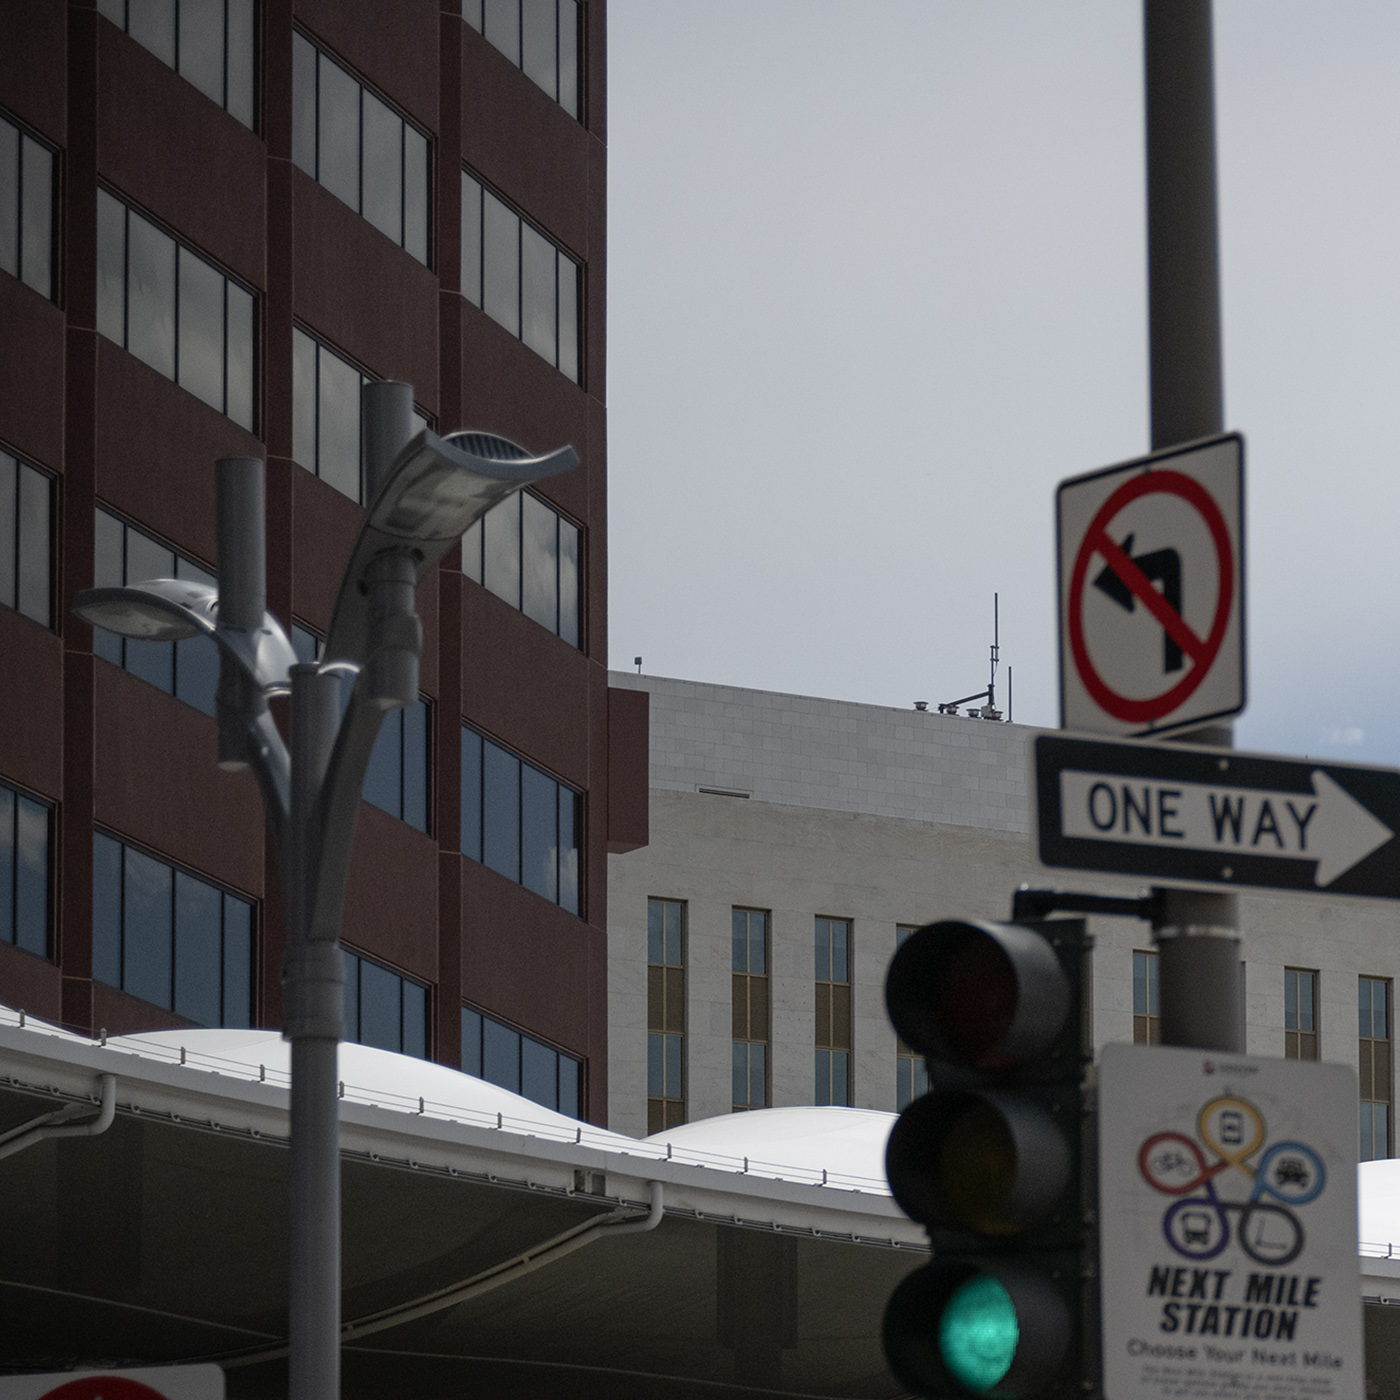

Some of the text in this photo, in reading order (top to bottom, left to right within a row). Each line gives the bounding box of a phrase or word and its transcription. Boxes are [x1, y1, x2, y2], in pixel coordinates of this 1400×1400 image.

[1089, 783, 1317, 850] ONE WAY
[1149, 1266, 1321, 1307] NEXT MILE
[1161, 1302, 1297, 1341] STATION
[1127, 1339, 1343, 1369] Choose Your Next Mile
